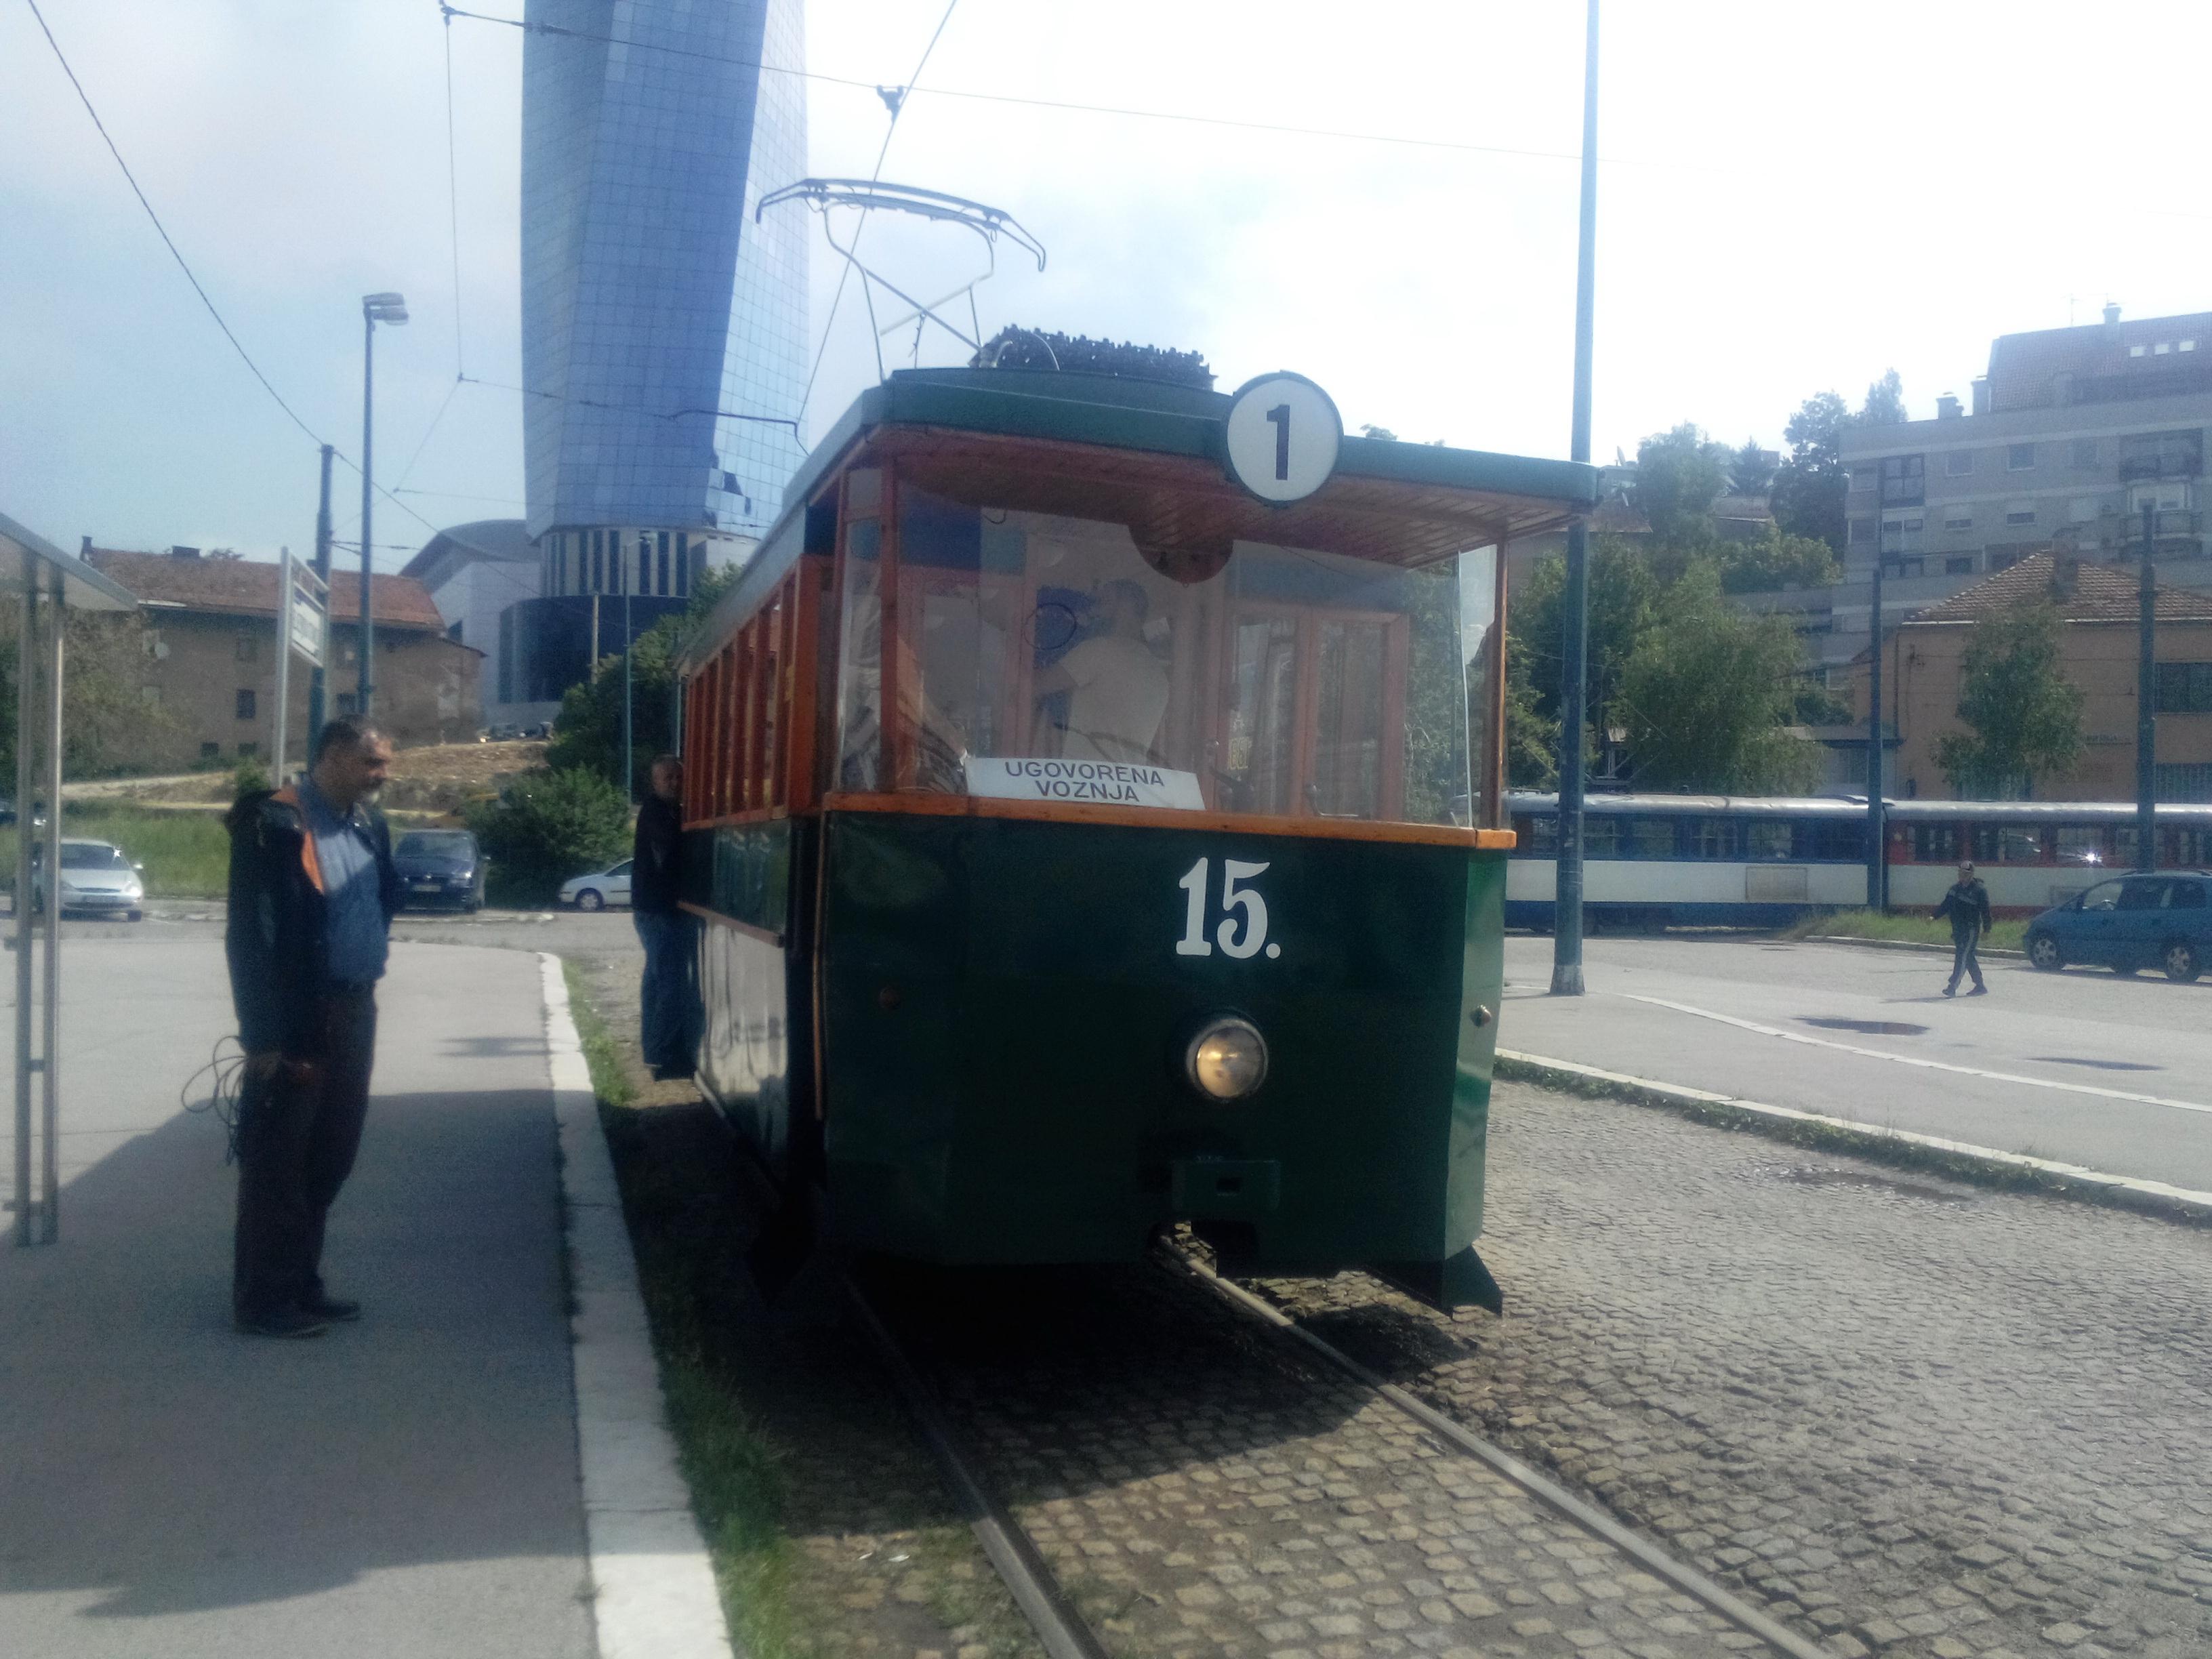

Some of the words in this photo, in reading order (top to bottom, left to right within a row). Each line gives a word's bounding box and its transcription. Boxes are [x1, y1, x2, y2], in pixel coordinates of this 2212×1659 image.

[1267, 405, 1290, 480] 1
[1005, 761, 1165, 787] UGOVORENA
[1036, 780, 1140, 802] VOZNJA
[1176, 857, 1281, 958] 15.
